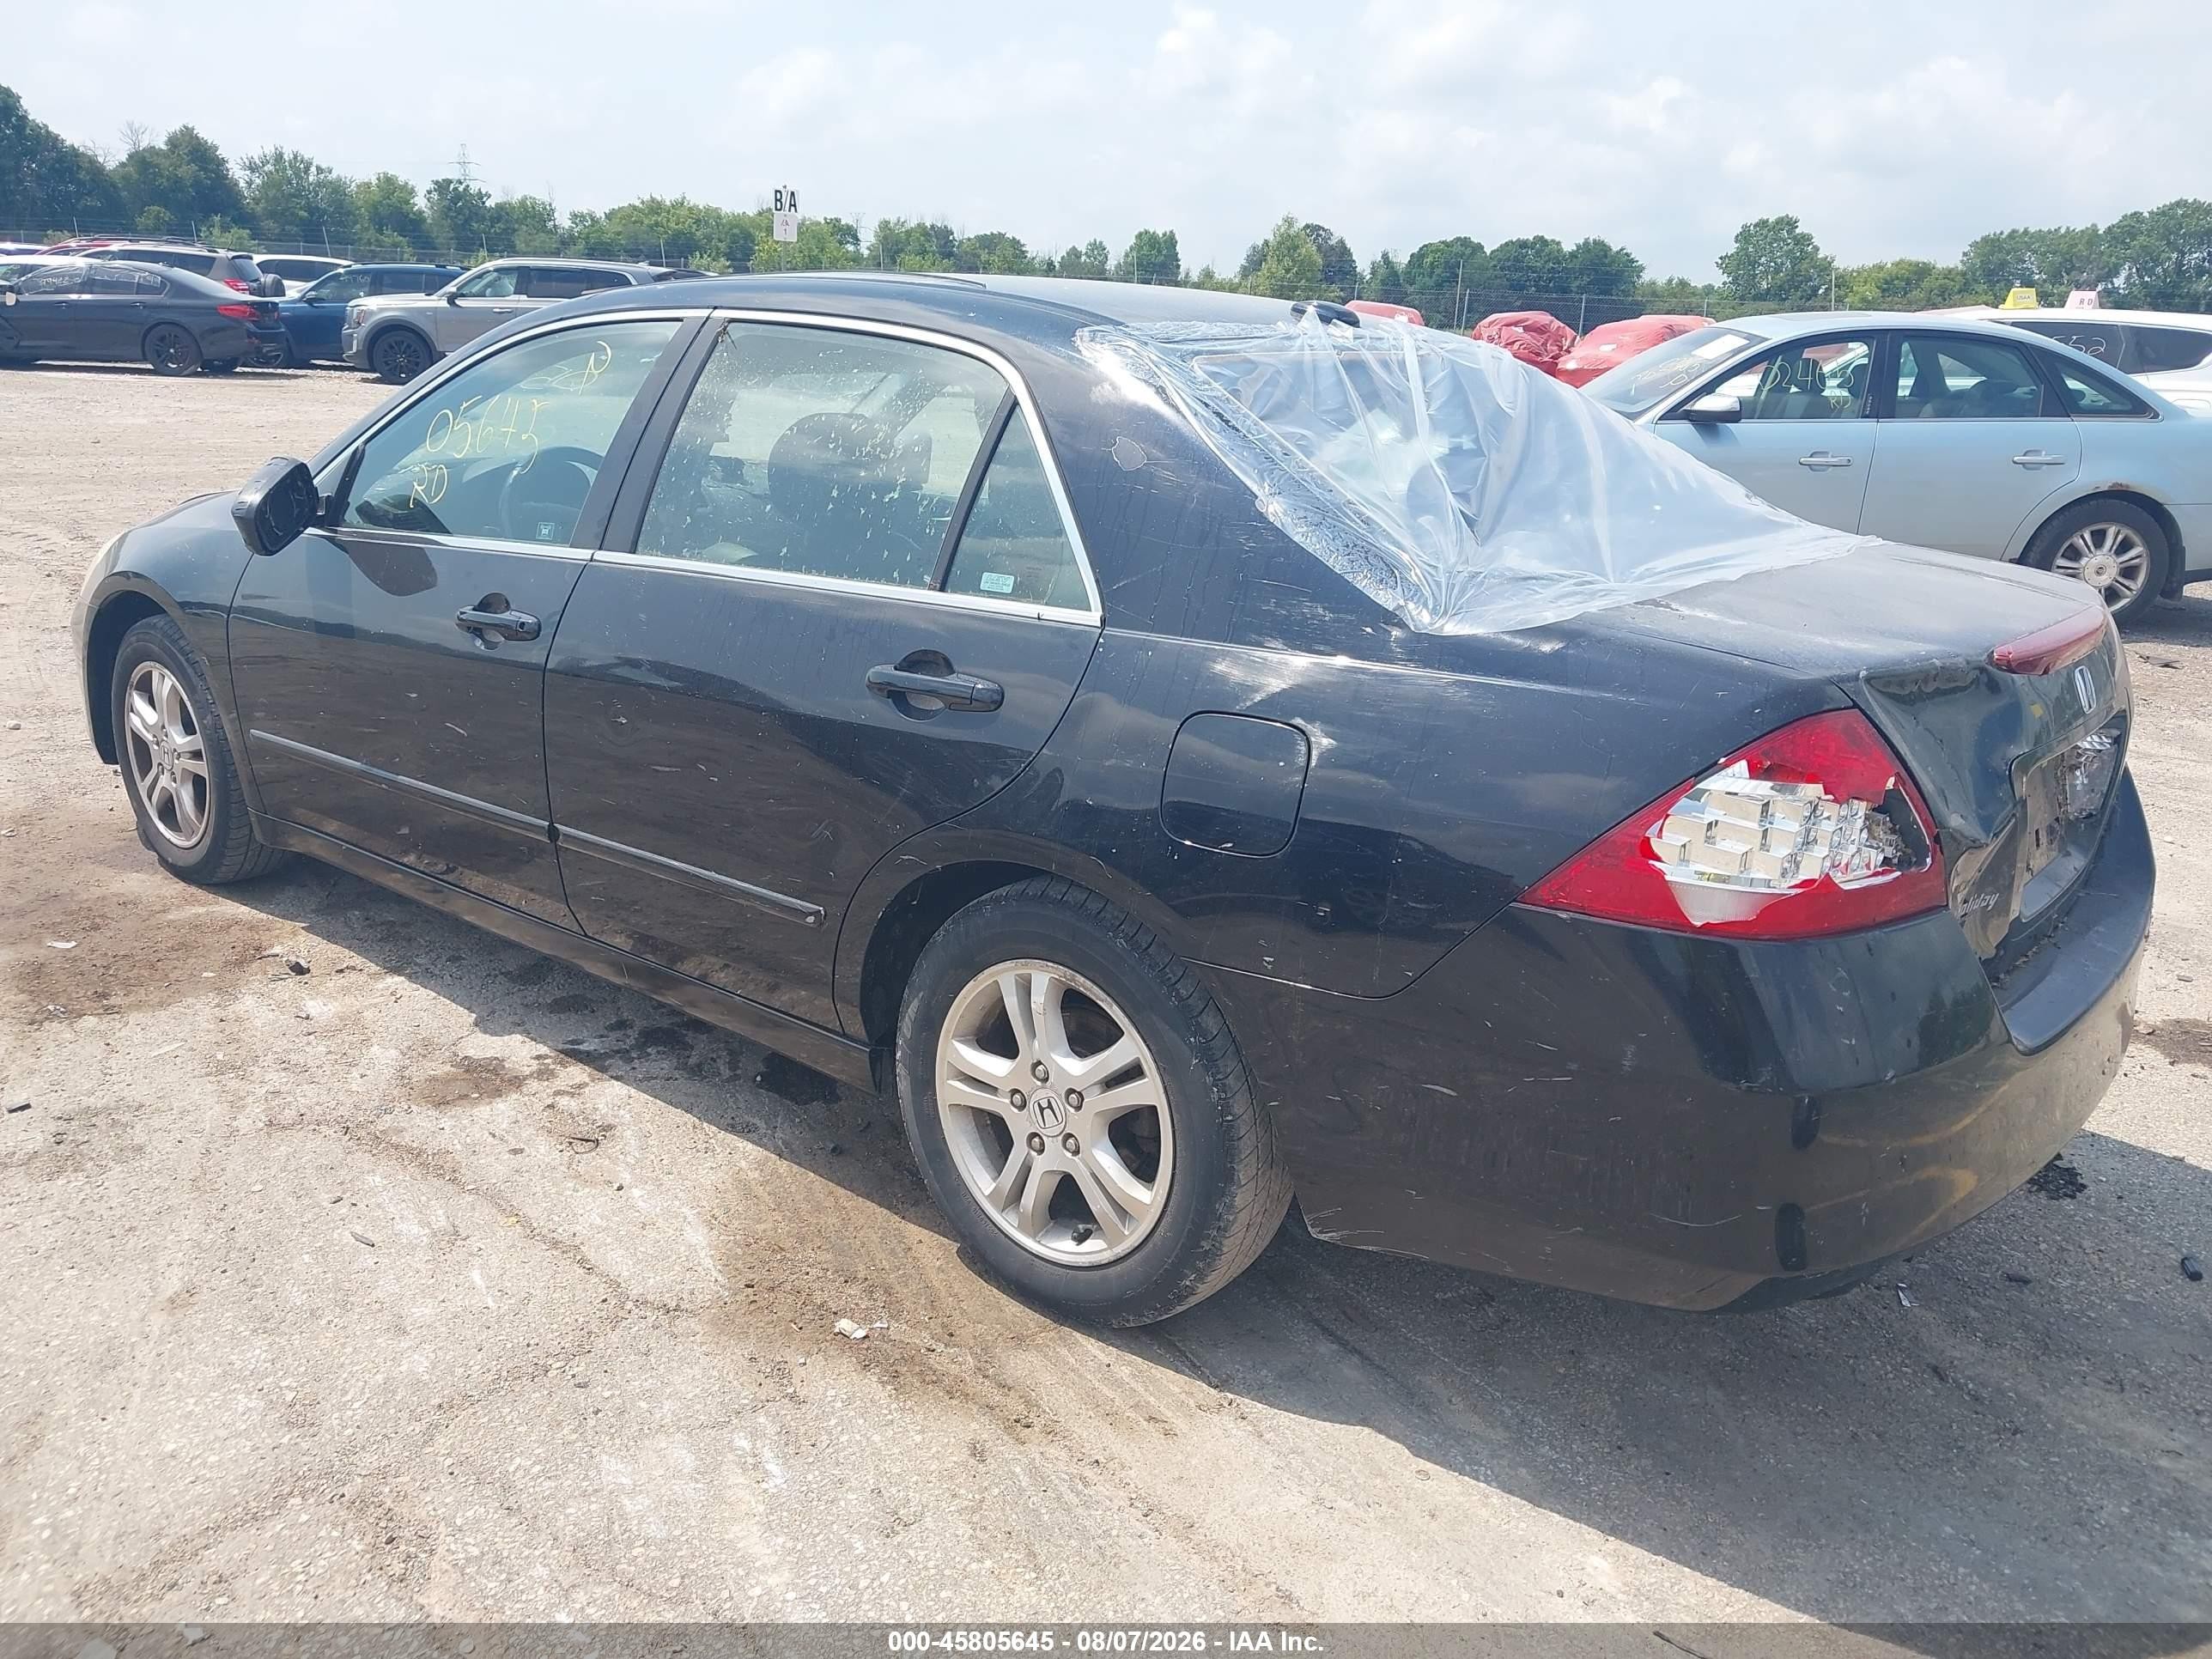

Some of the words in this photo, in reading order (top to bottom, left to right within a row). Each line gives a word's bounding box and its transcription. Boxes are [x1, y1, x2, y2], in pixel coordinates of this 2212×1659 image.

[775, 189, 798, 213] B/A
[410, 464, 448, 508] RD
[1958, 892, 2000, 915] oliday
